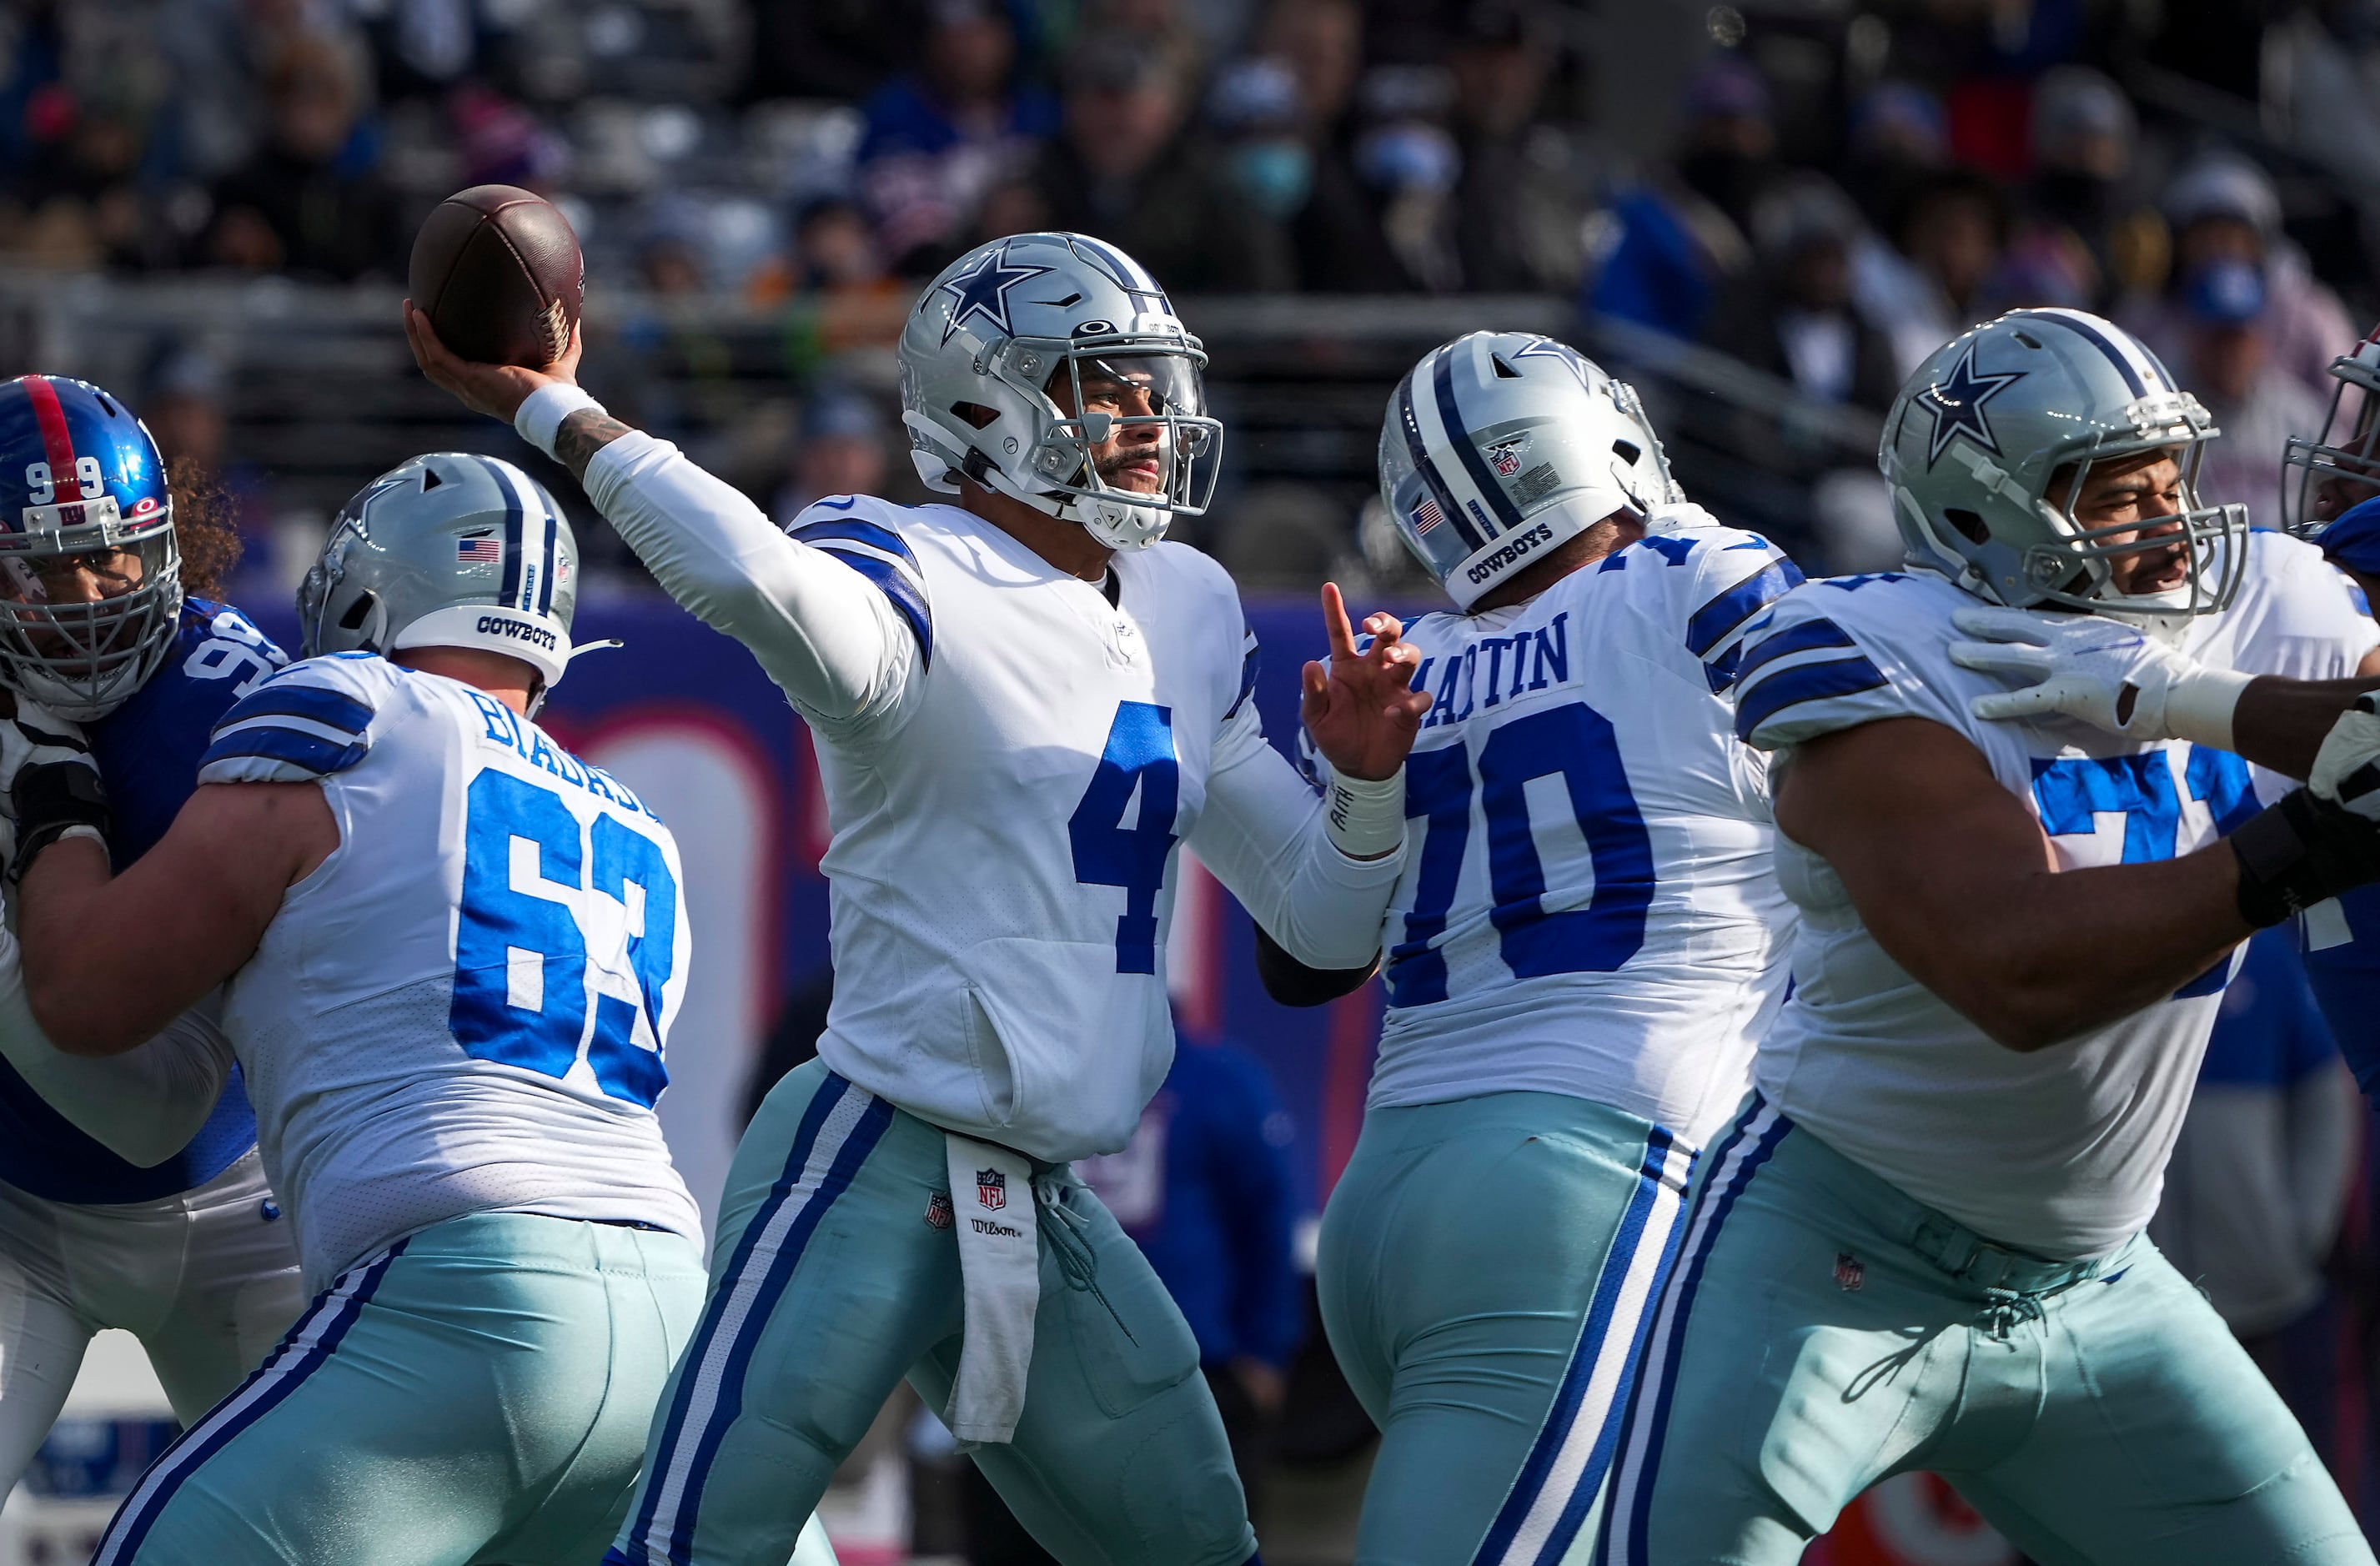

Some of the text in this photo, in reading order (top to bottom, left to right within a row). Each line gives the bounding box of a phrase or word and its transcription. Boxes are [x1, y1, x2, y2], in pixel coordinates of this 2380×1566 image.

[26, 456, 104, 504] 99
[1498, 456, 1519, 476] NFL
[1467, 522, 1554, 585] COWBOYS
[1330, 786, 1354, 832] FAITH
[1067, 700, 1179, 975] 4
[1387, 701, 1656, 1008] 70
[448, 766, 676, 1110] 63
[978, 1186, 1004, 1207] NFL
[971, 1218, 1017, 1237] Wilson
